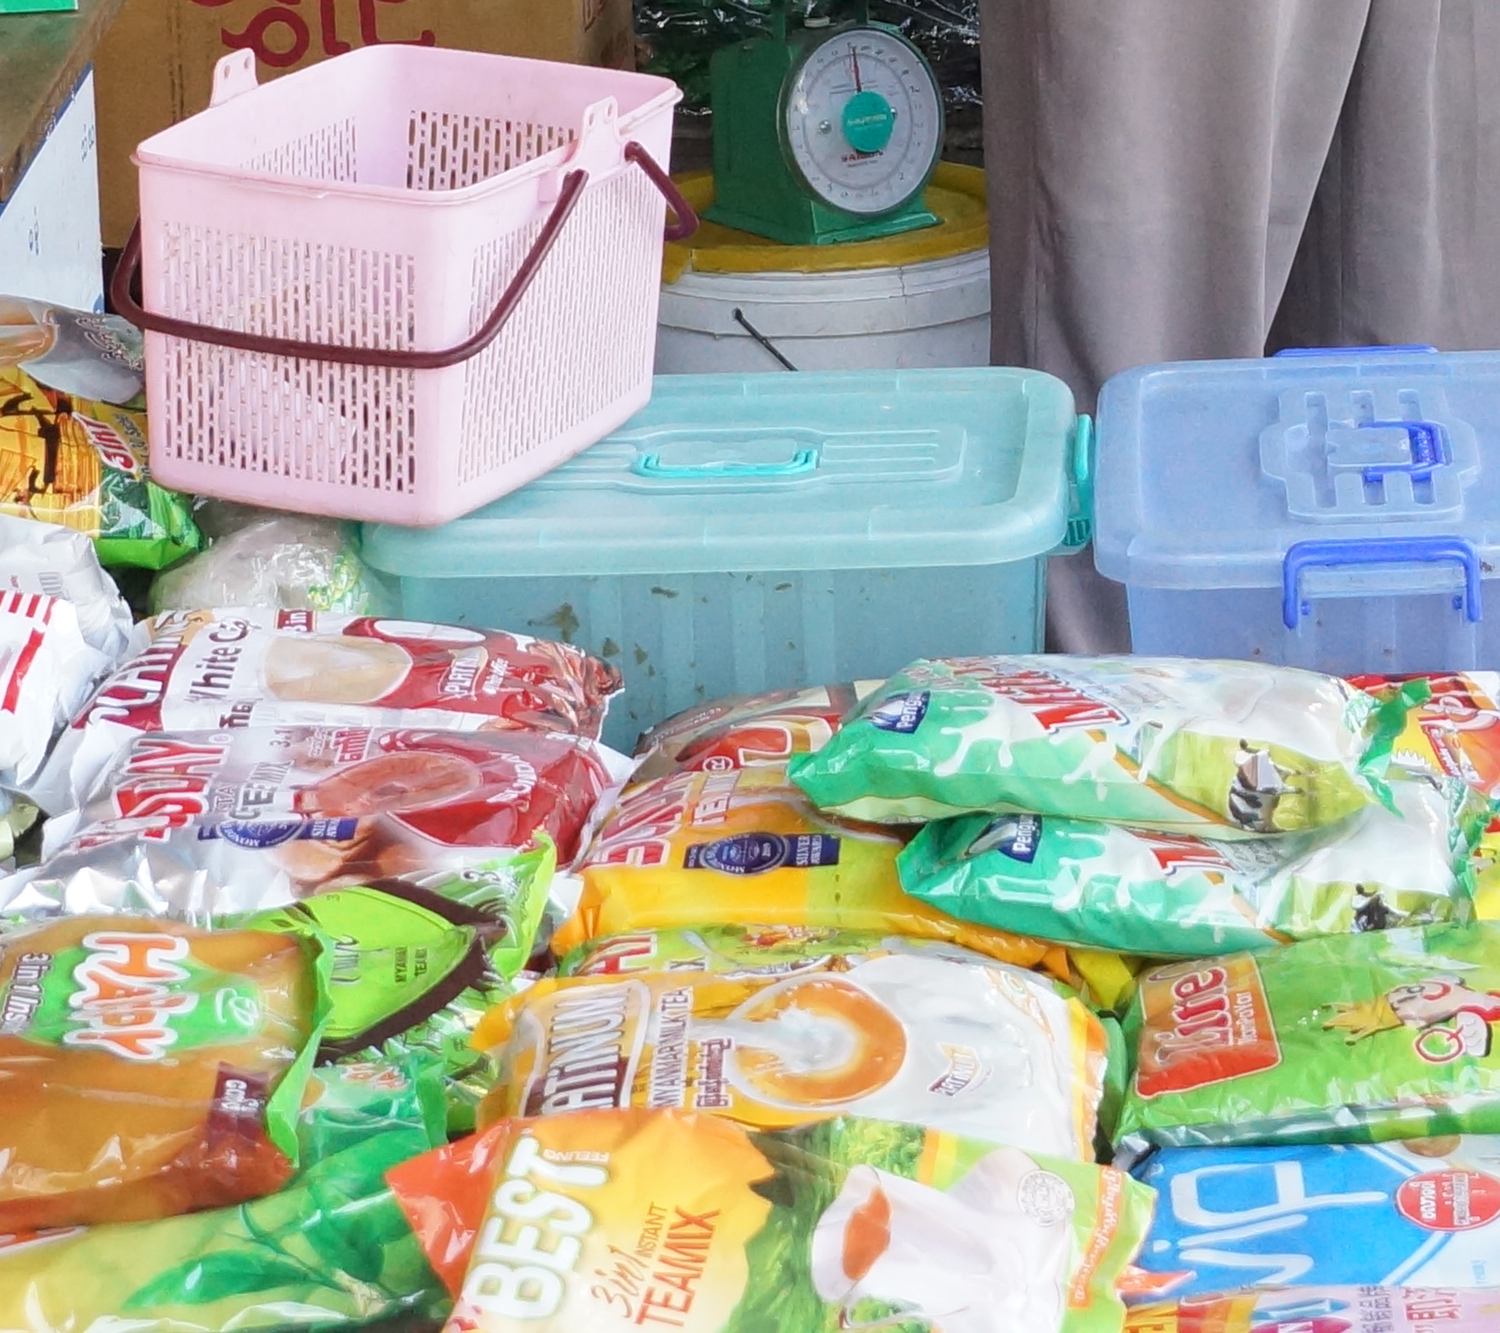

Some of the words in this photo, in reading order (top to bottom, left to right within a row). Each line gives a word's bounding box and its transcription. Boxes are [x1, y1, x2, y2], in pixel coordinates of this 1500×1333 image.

[796, 835, 811, 867] SILVER
[467, 1132, 609, 1321] BEST
[635, 1206, 722, 1327] TEAMIX
[637, 1201, 668, 1259] INSTANT
